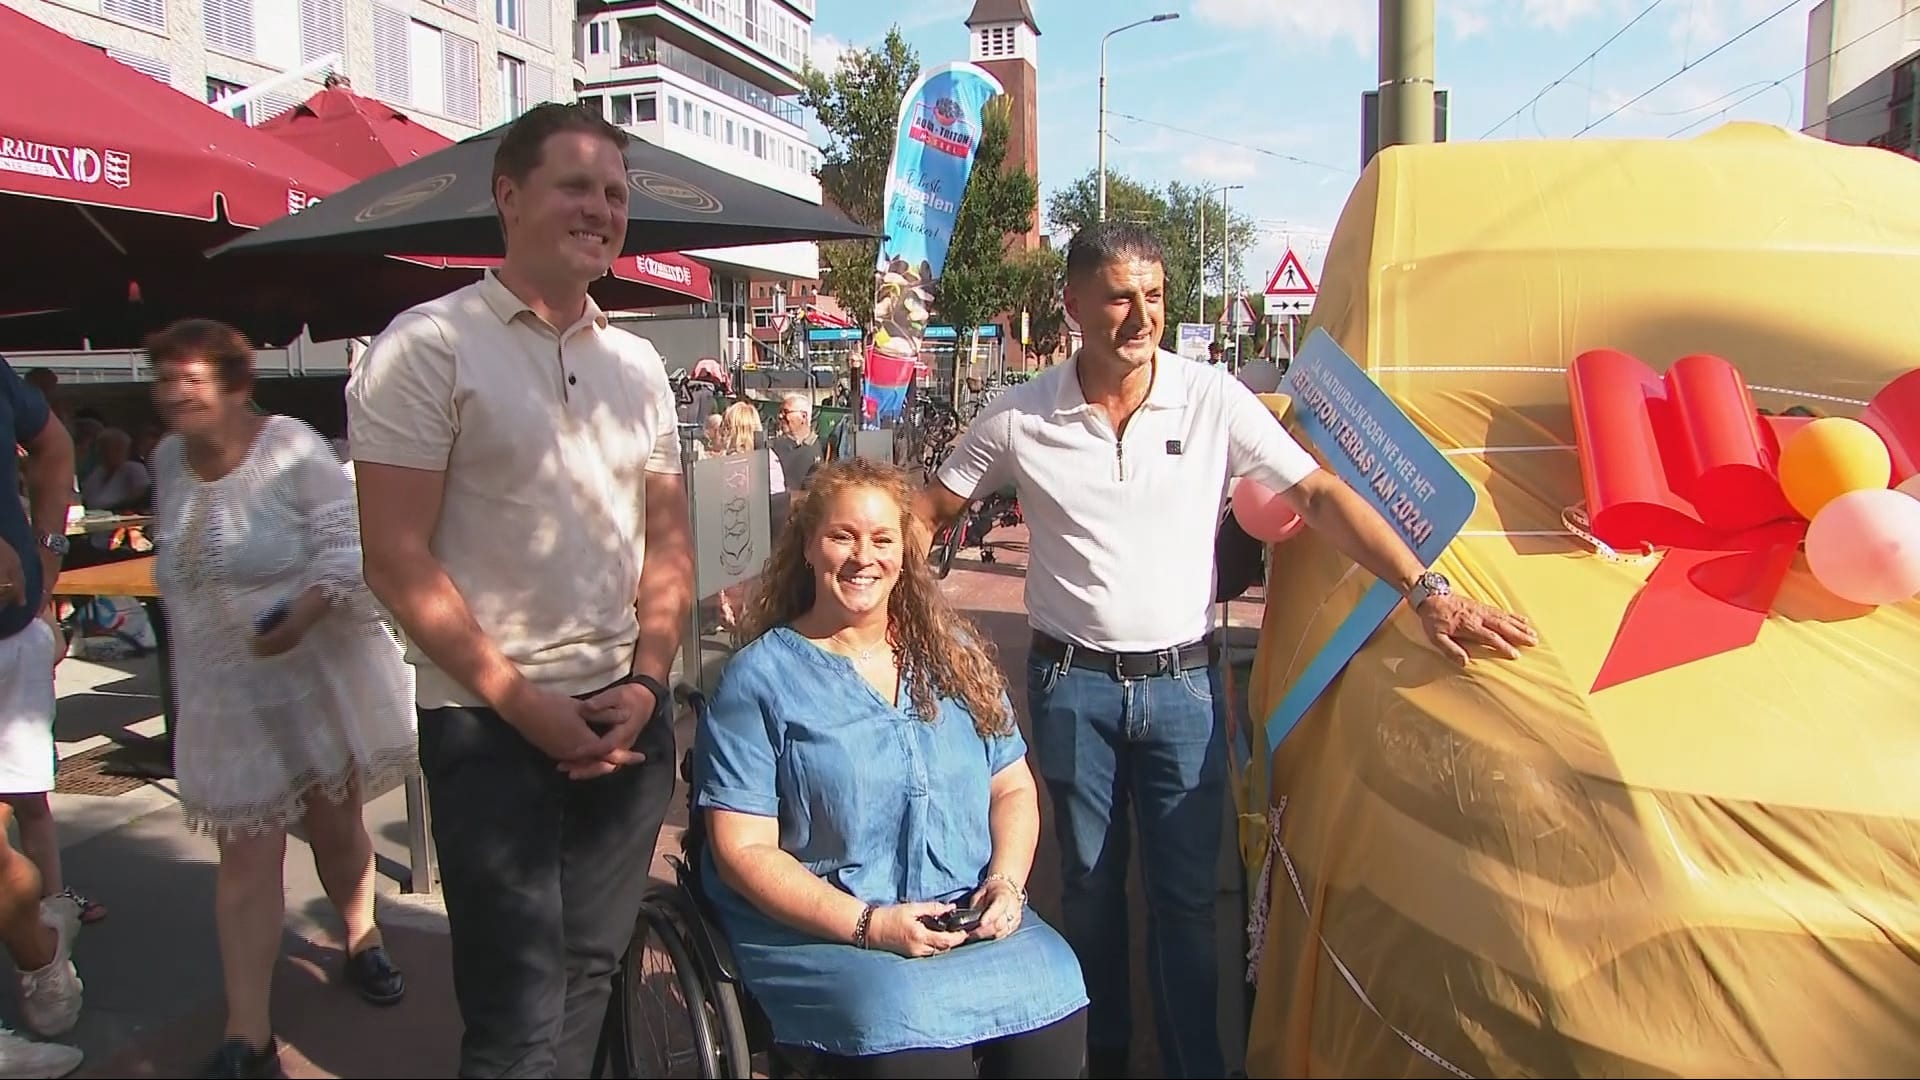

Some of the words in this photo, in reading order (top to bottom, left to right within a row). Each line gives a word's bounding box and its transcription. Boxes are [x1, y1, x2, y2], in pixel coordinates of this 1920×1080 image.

[0, 137, 72, 180] RAUTZ
[940, 127, 971, 143] TRITON
[1291, 368, 1309, 393] HET
[1303, 383, 1340, 431] LIPTON
[1335, 417, 1375, 475] TERRAS
[1370, 462, 1398, 504] VAN
[1391, 492, 1433, 546] 2024!
[1320, 369, 1367, 424] NATUURLIJK
[1361, 415, 1388, 447] DOEN
[1382, 438, 1400, 462] WE
[1393, 453, 1417, 482] MEE
[1410, 474, 1436, 503] MET
